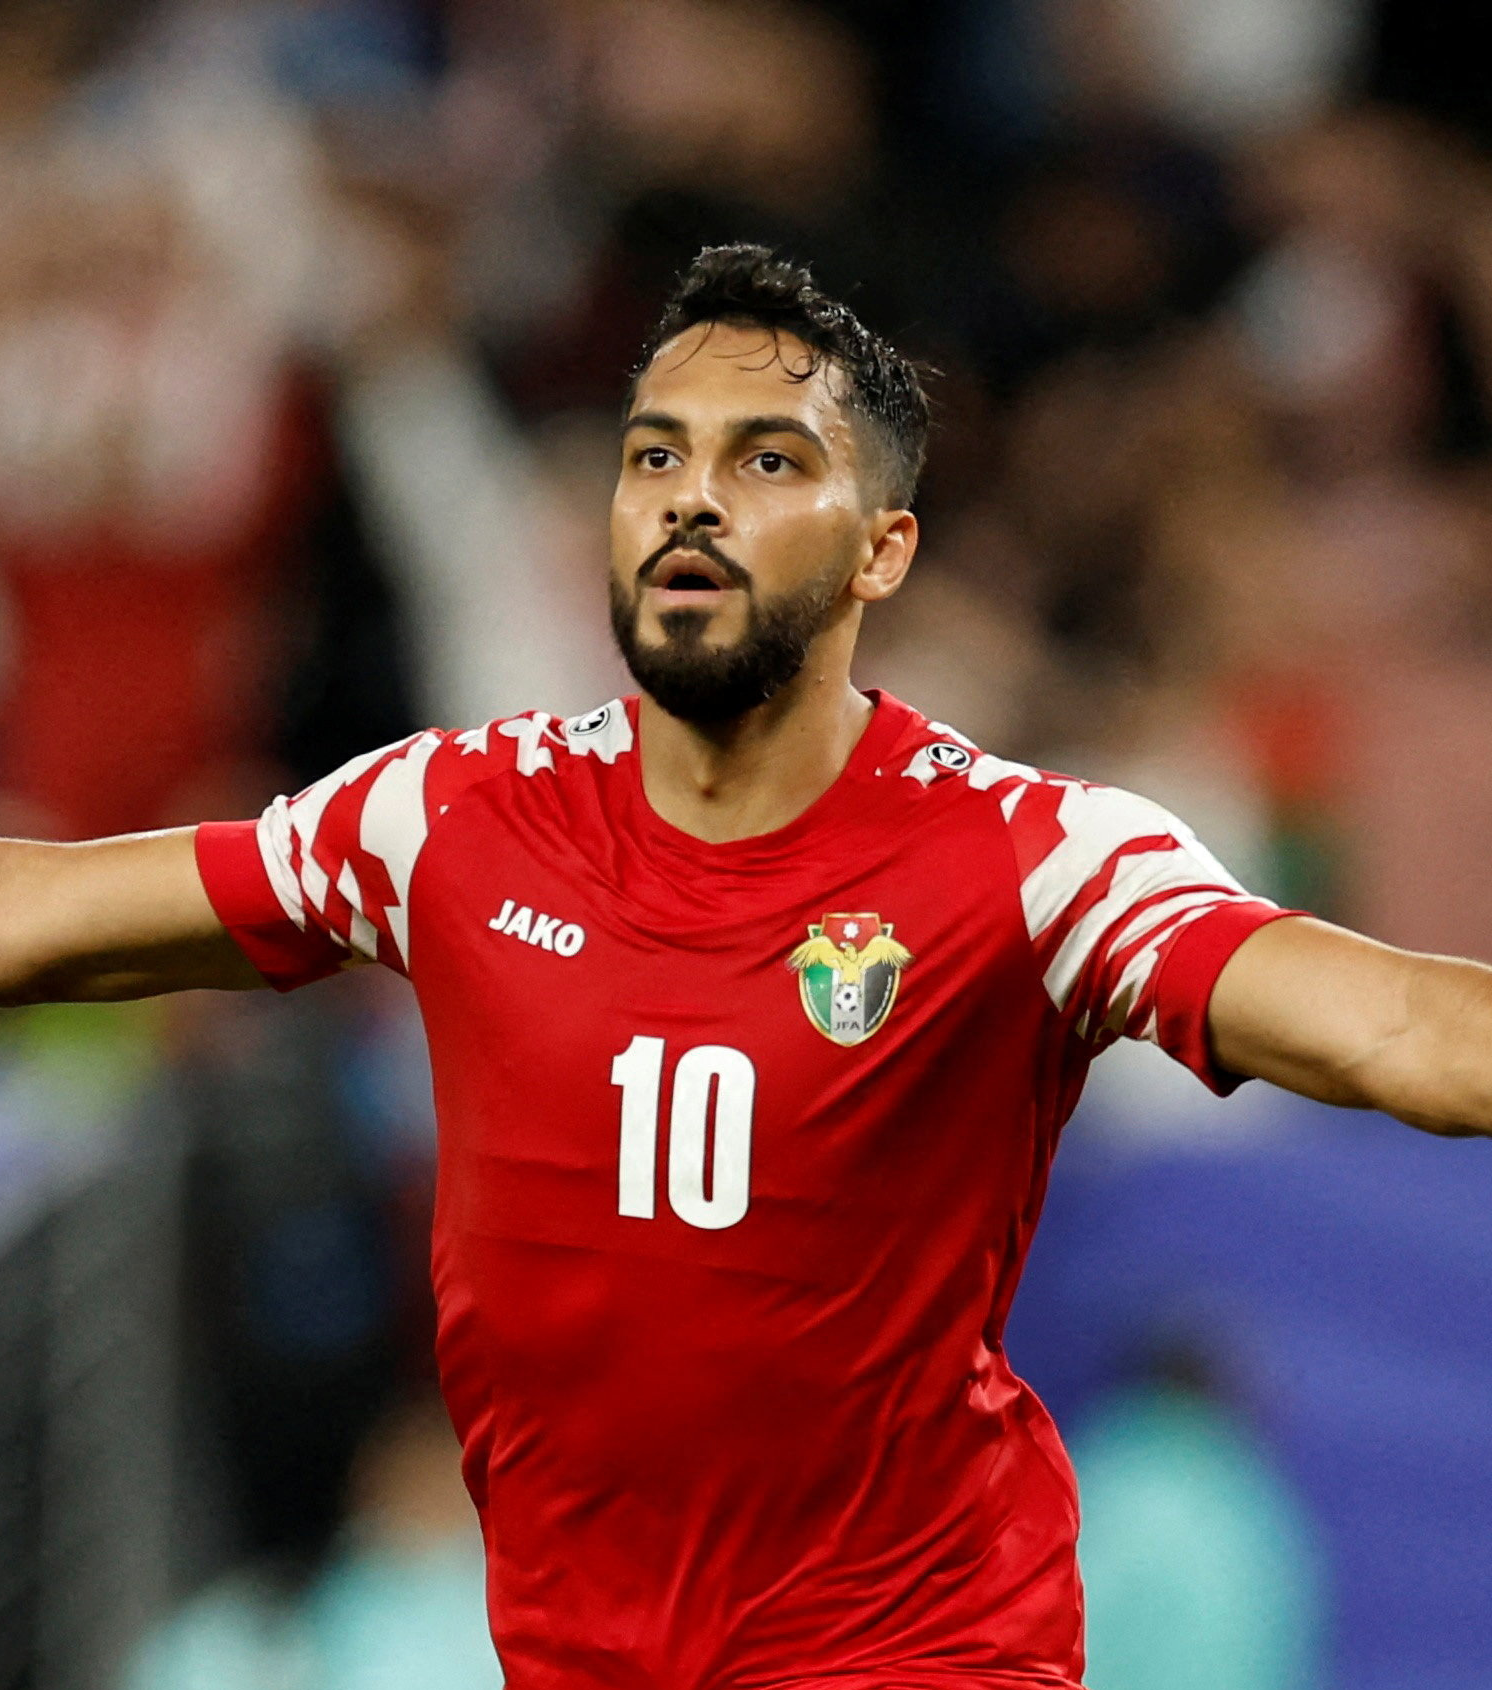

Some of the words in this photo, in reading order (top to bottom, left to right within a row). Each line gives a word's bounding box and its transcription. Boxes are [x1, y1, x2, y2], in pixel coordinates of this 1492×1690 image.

[488, 899, 585, 957] JAKO
[834, 1021, 861, 1031] JFA
[610, 1035, 756, 1230] 10
